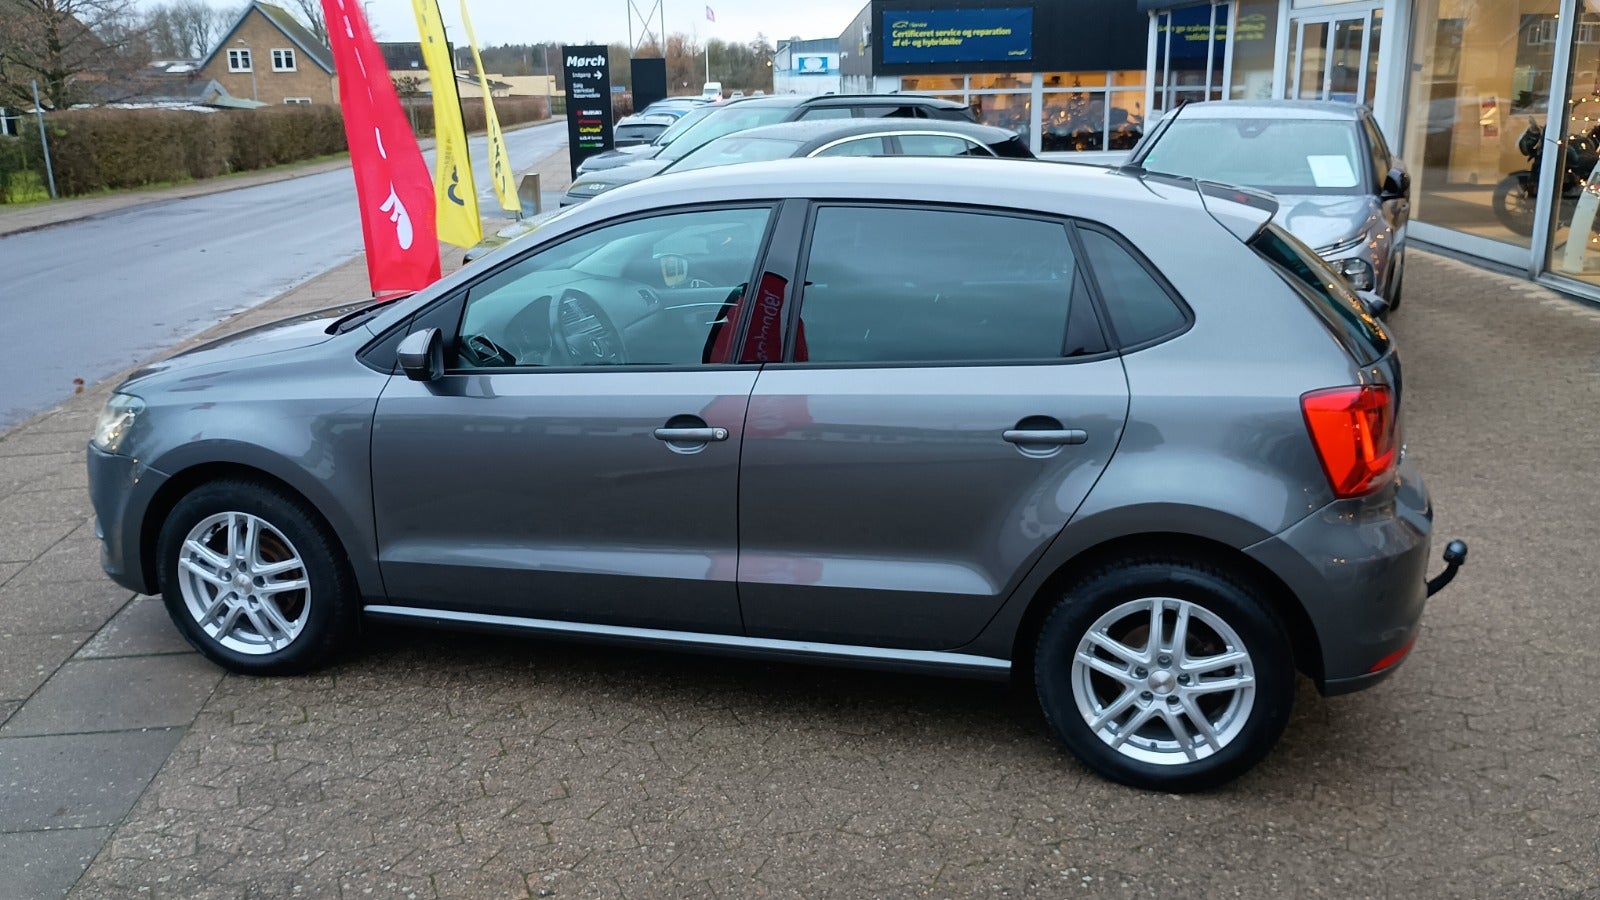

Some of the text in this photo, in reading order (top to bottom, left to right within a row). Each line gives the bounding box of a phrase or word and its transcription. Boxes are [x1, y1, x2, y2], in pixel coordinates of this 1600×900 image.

[892, 28, 1011, 38] Certificeret service og reparation
[892, 38, 963, 48] af el- og hybridbiler
[566, 54, 606, 67] Mørch
